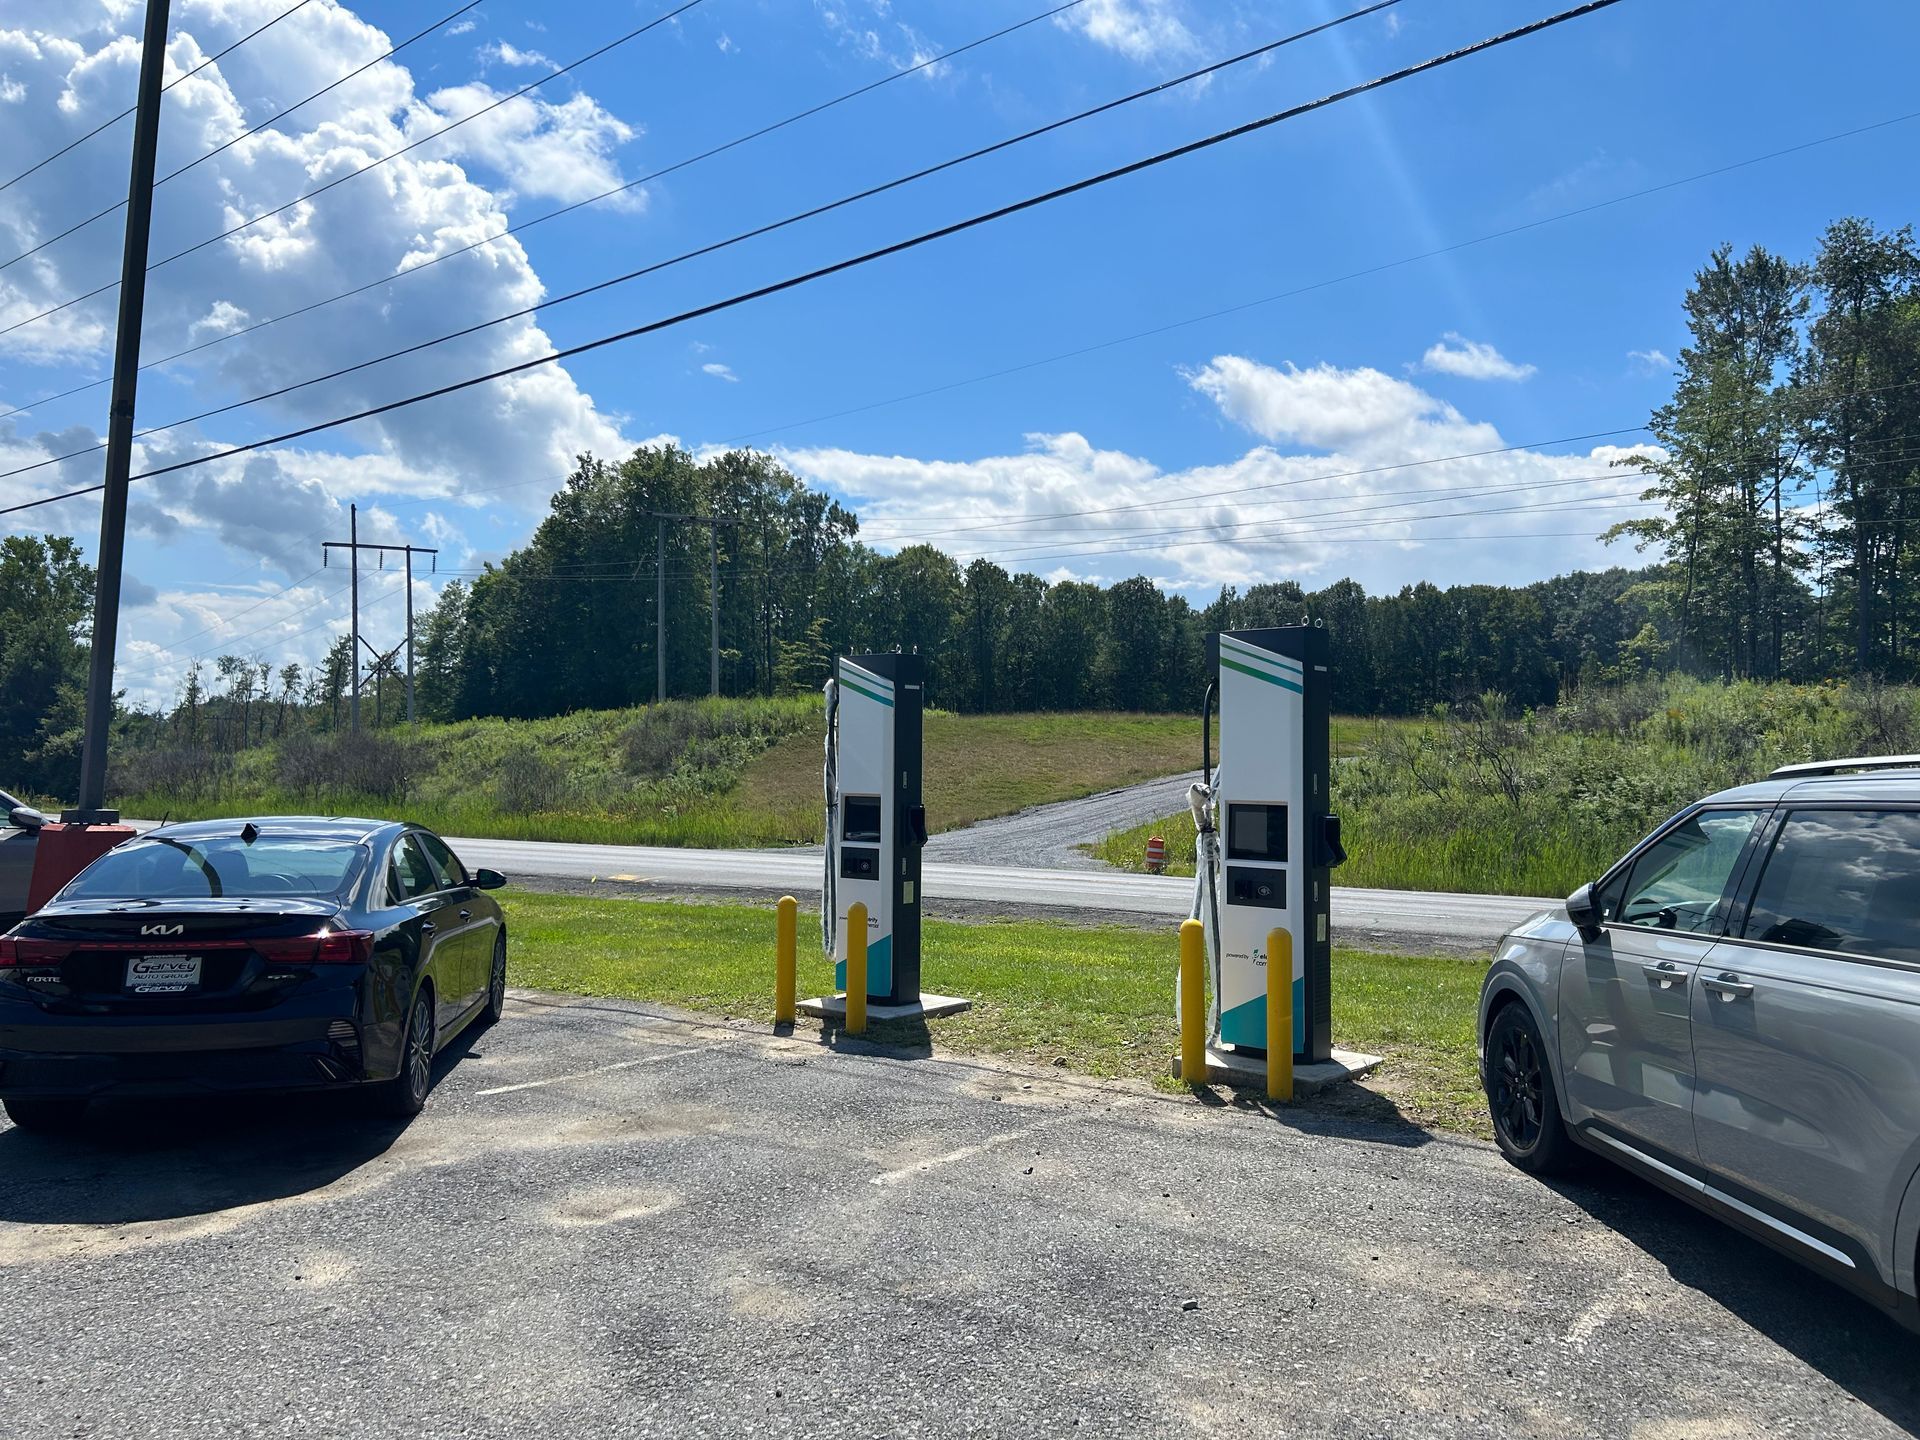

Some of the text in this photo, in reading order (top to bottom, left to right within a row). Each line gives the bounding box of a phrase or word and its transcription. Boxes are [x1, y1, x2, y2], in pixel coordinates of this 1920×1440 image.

[141, 925, 184, 935] KIA
[132, 962, 197, 974] Garvey
[135, 985, 188, 993] Garvey
